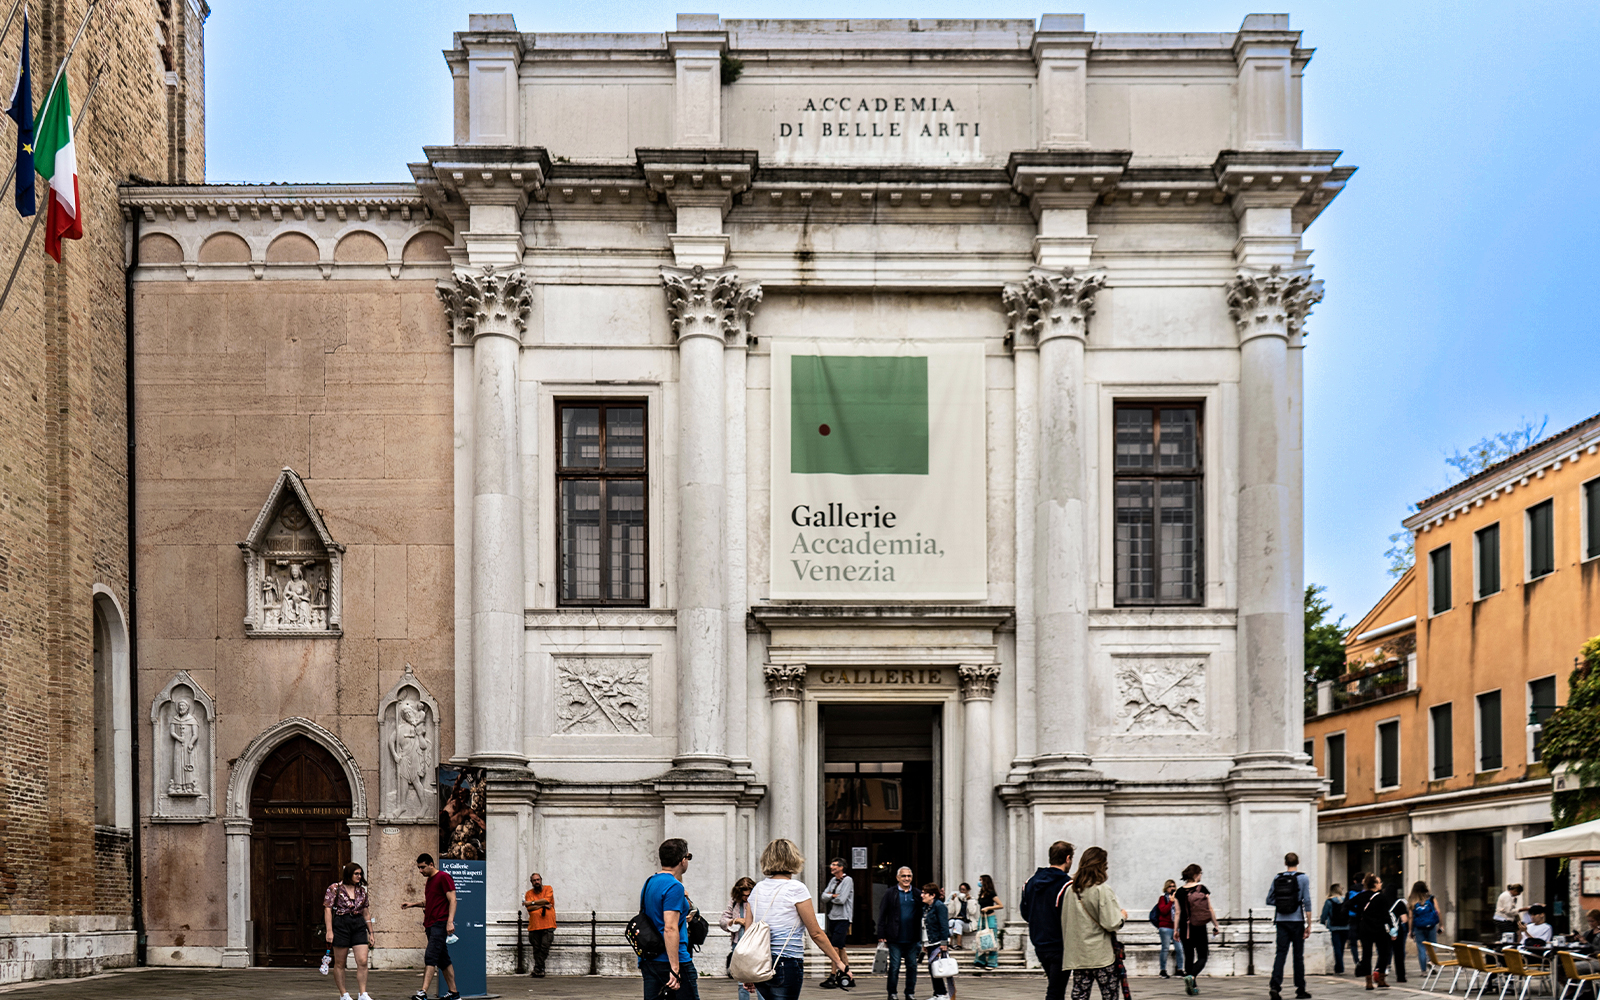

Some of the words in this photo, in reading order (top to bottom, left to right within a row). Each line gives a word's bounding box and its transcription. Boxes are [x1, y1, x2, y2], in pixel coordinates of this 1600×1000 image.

[804, 97, 955, 112] ACCADEMIA
[780, 122, 804, 137] DI
[822, 122, 900, 137] BELLE
[920, 122, 980, 137] ARTI
[791, 502, 897, 528] Gallerie
[790, 531, 945, 558] Accademia,
[790, 559, 896, 582] Venezia
[820, 669, 942, 684] GALLERIE
[264, 807, 304, 815] ACCADEMIA
[313, 807, 332, 815] BELLE
[335, 807, 351, 815] ARTI
